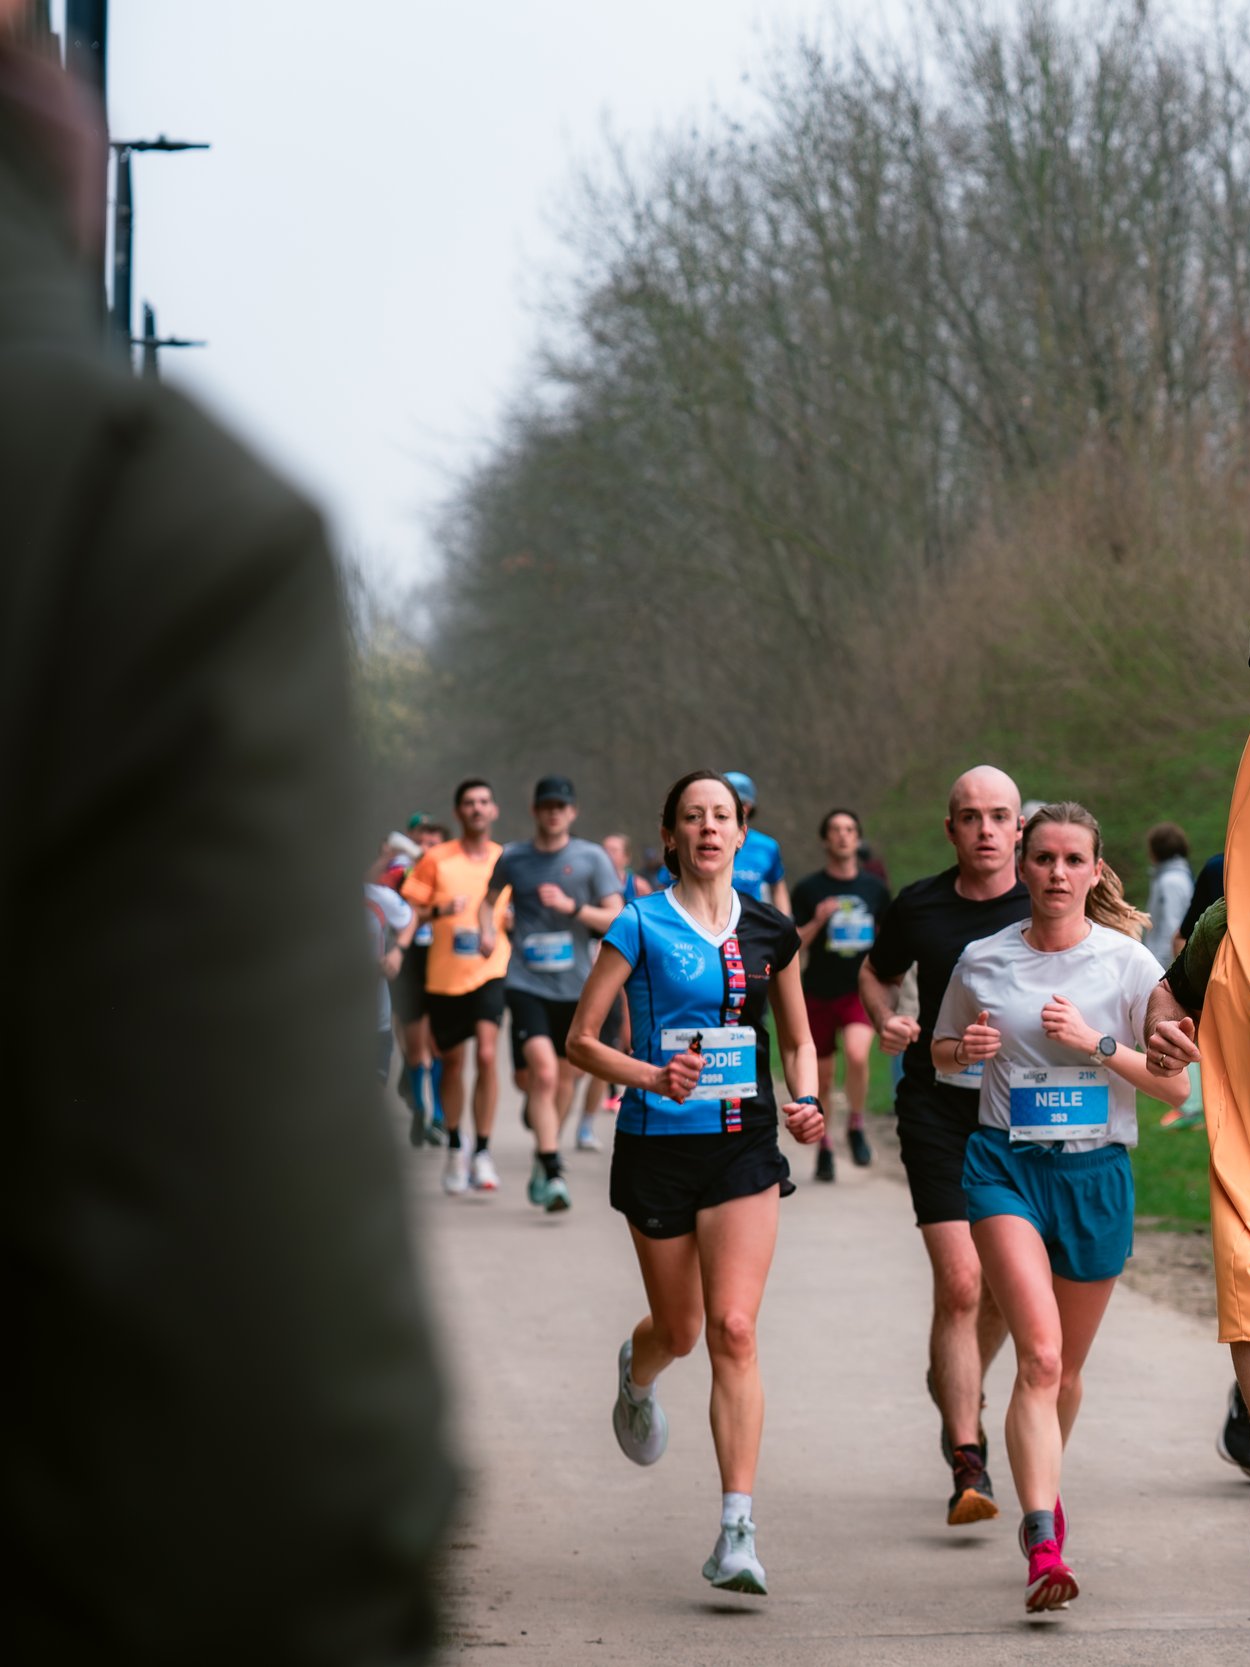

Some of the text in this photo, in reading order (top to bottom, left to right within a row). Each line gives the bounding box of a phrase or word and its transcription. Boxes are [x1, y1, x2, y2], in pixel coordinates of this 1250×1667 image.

[730, 1032, 746, 1040] 21K
[702, 1050, 742, 1068] ODIE
[1078, 1071, 1097, 1080] 21K
[1035, 1091, 1083, 1107] NELE
